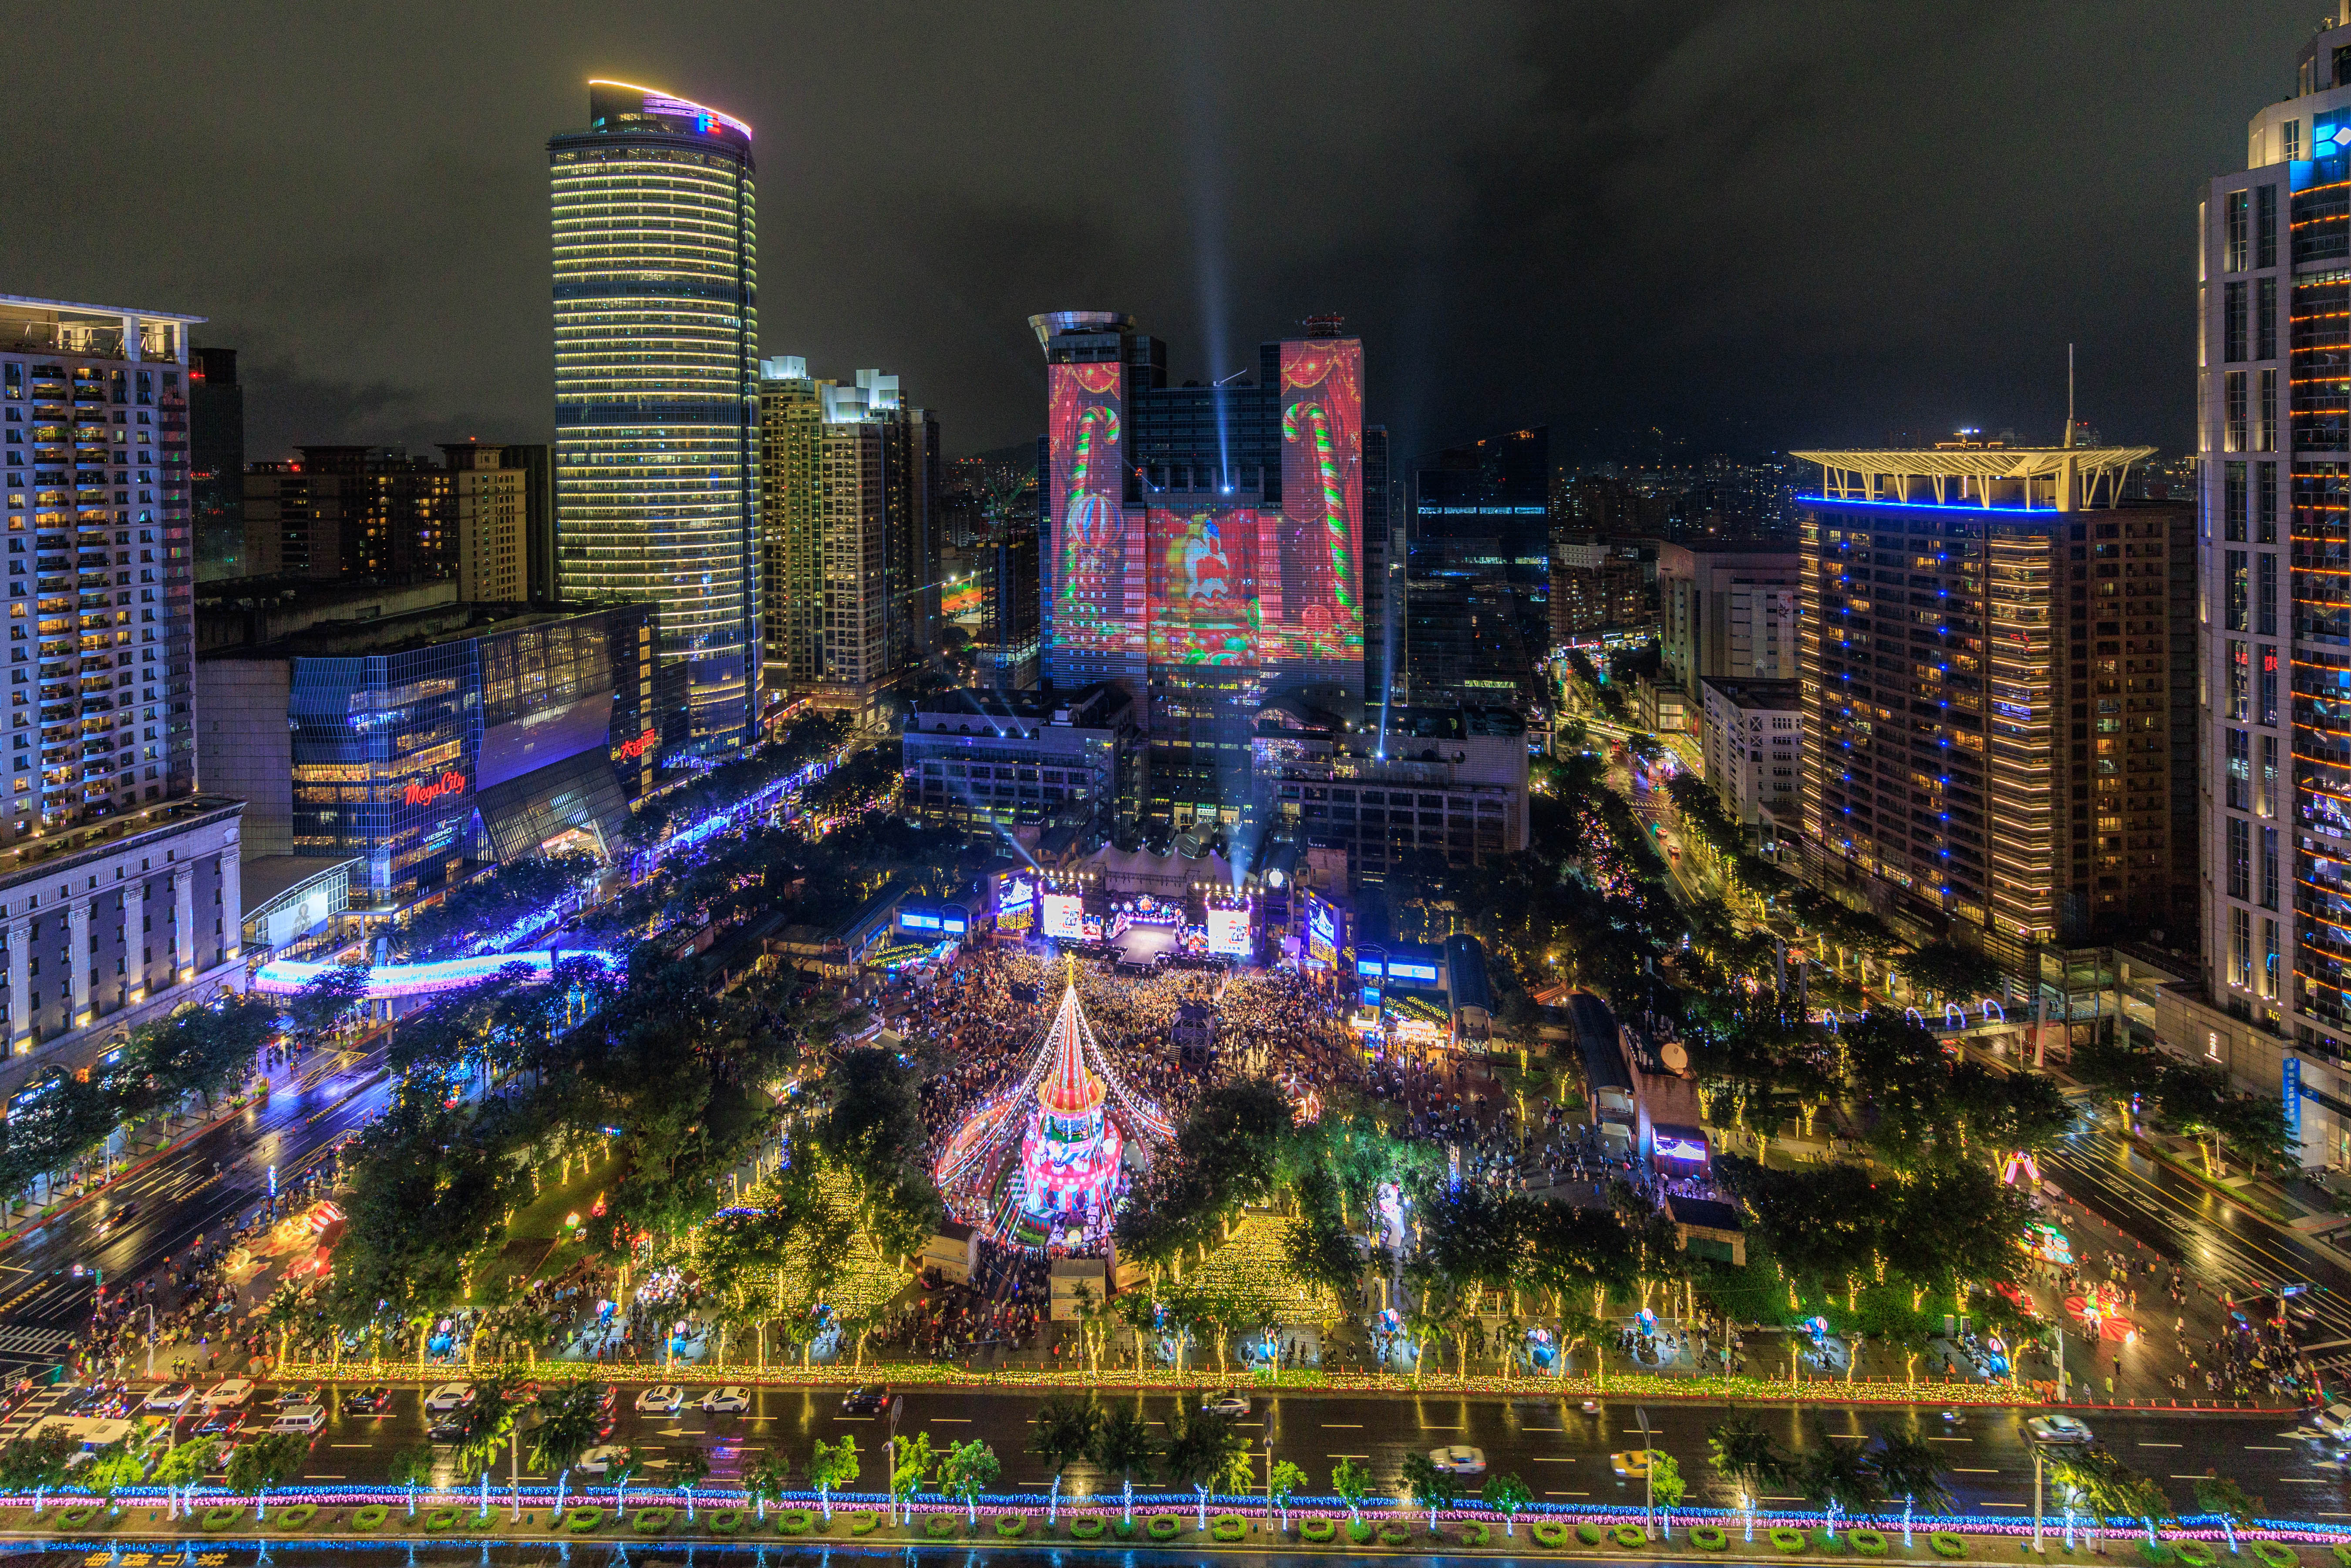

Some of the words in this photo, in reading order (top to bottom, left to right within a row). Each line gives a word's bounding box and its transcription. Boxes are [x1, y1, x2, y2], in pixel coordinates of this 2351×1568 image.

[620, 728, 655, 759] 大遠百
[404, 783, 441, 806] Mega
[441, 771, 465, 794] City
[423, 825, 458, 843] VIESHOW
[428, 838, 452, 852] IMAX
